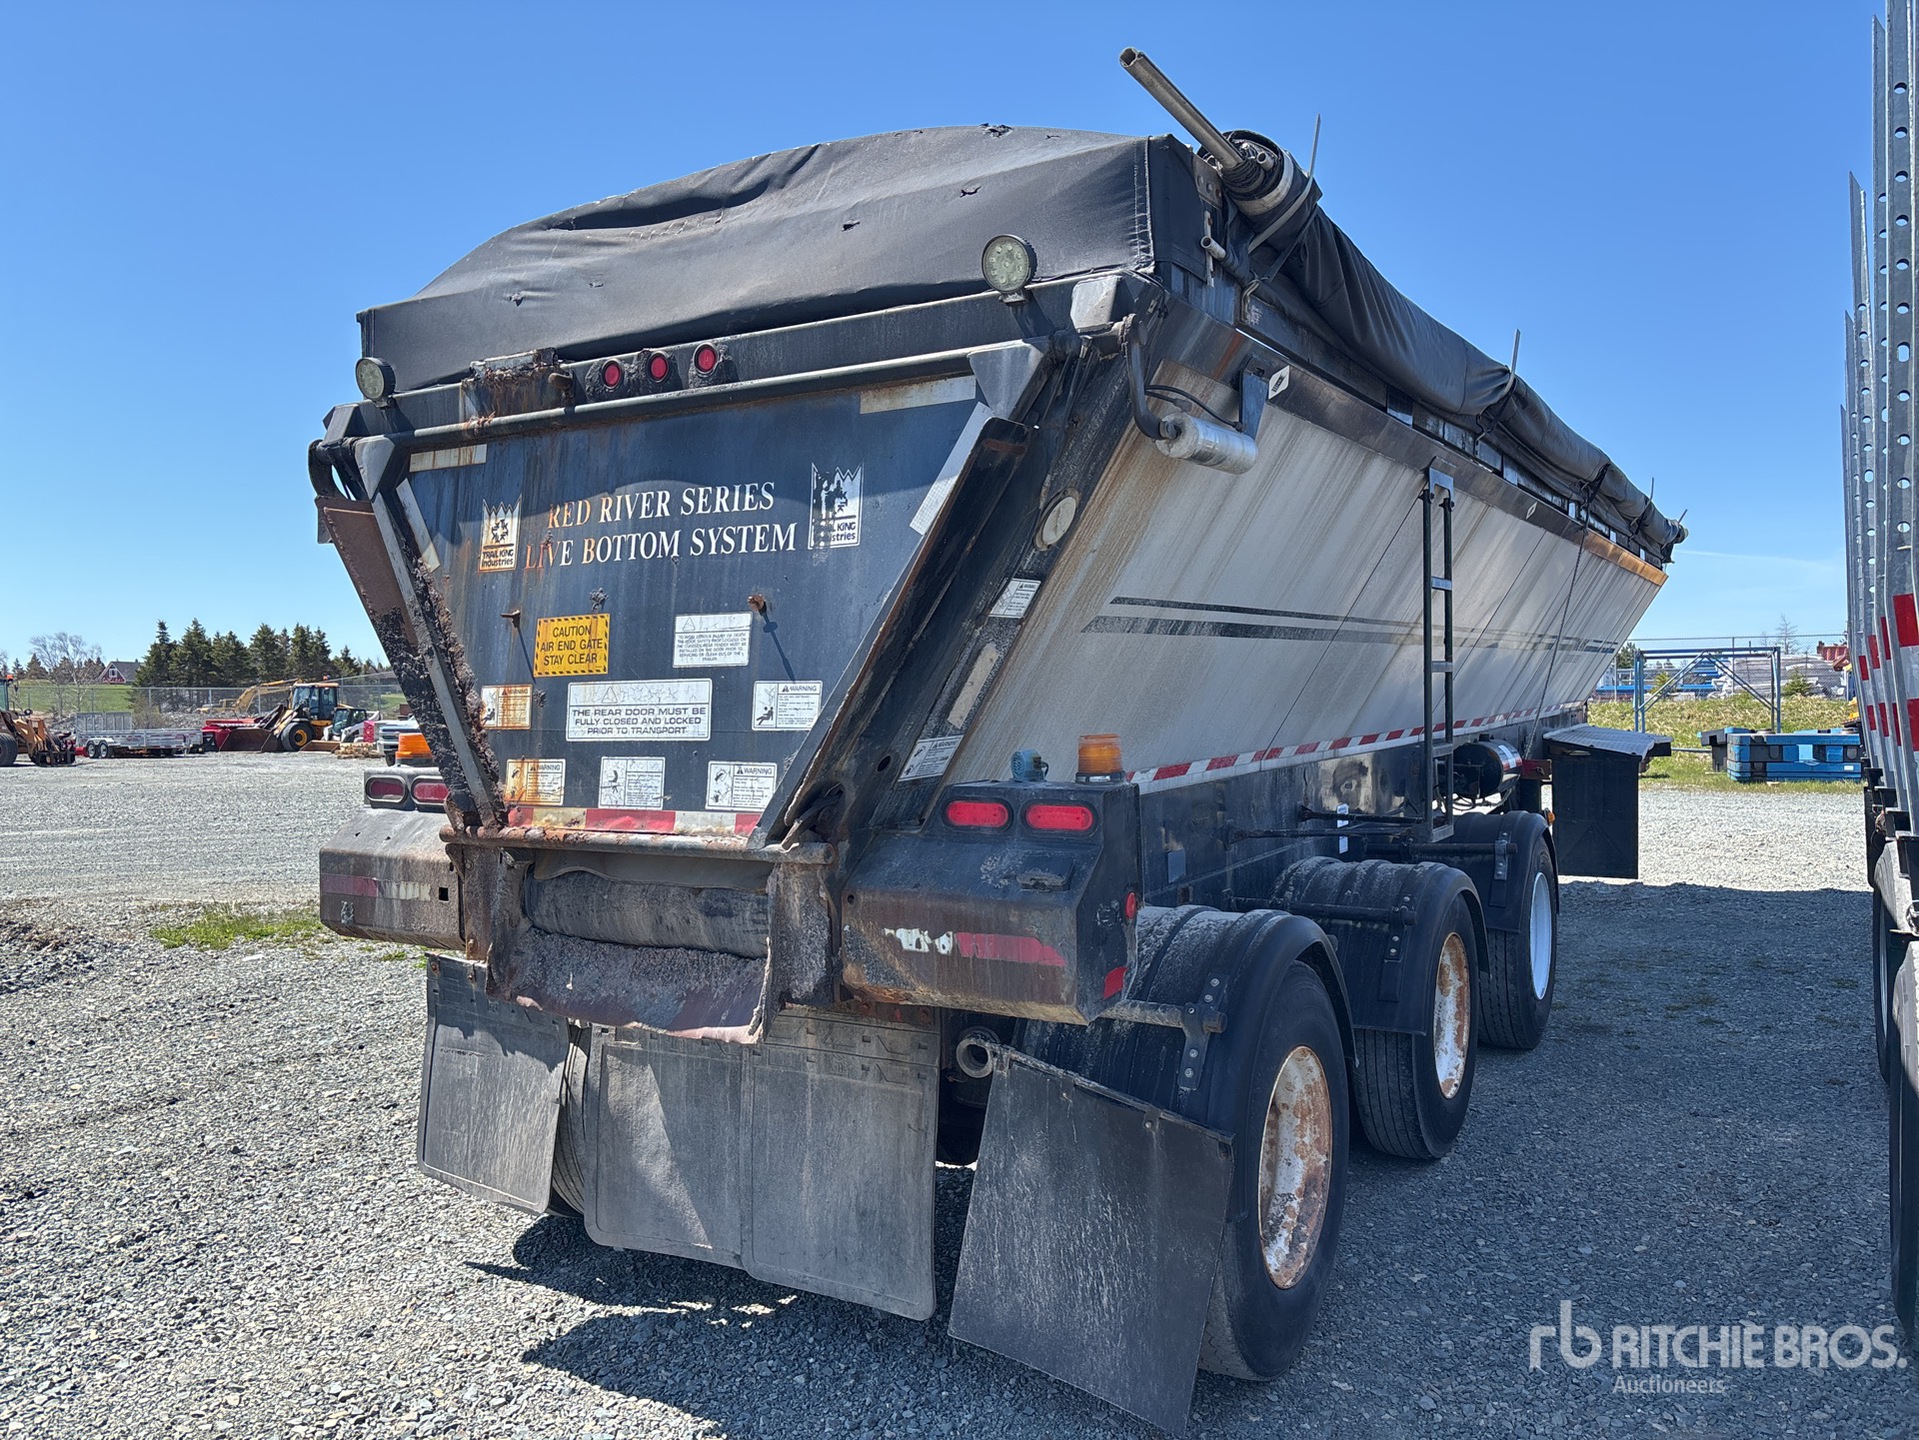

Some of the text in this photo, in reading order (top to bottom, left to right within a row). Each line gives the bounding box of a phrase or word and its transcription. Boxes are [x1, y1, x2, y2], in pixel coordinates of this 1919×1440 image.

[548, 481, 775, 529] RED RIVER SERIES
[524, 522, 798, 570] LIVE BOTTOM SYSTEM
[482, 550, 498, 559] TRAIL
[552, 625, 592, 638] CAUTION
[540, 638, 603, 652] AIR END GATE
[543, 653, 598, 666] STAY CLEAR
[572, 706, 706, 717] THE REAR DOOR MUST BE
[575, 716, 702, 726] FULLY CLOSED AND LOCKED
[587, 726, 687, 735] PRIOR TO TRANSPORT
[744, 767, 772, 775] WARNING
